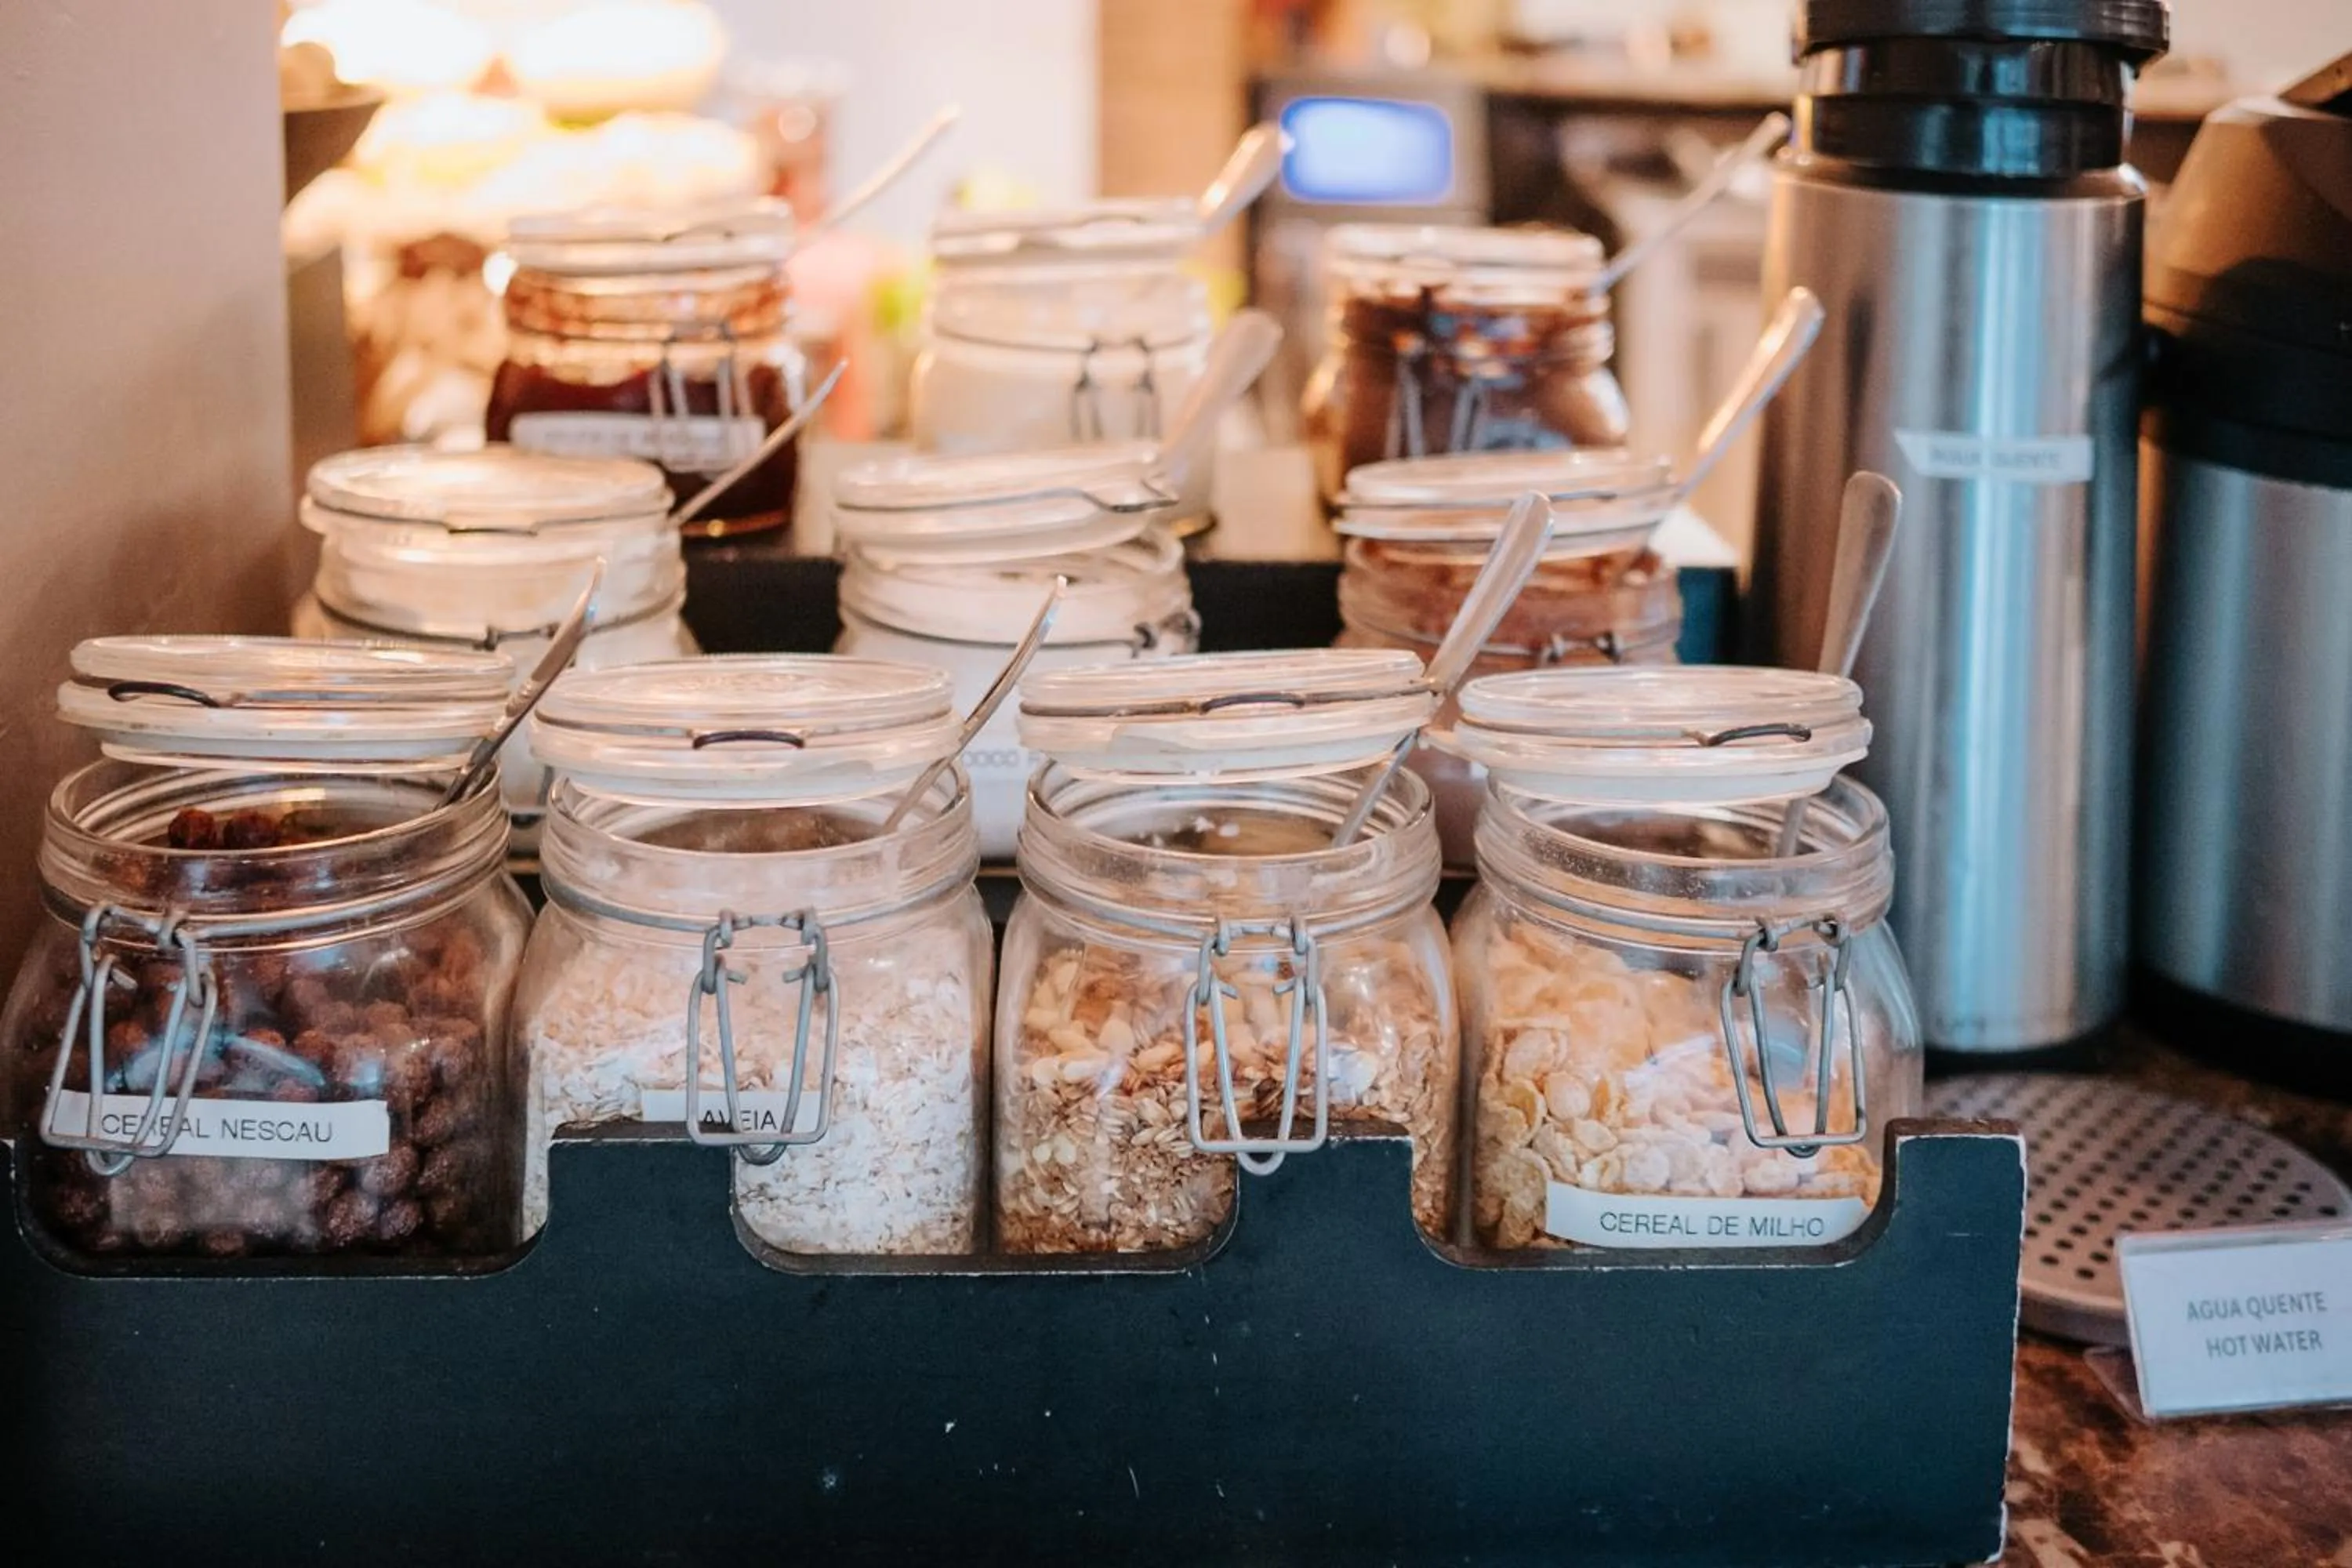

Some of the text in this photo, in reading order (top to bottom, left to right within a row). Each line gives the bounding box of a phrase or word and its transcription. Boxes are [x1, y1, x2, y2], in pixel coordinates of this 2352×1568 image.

[221, 1118, 332, 1142] NESCAU
[1599, 1212, 1825, 1237] CEREAL DE MILHO
[2187, 1292, 2328, 1321] AGUA QUENTE
[2205, 1330, 2323, 1358] HOT WATER
